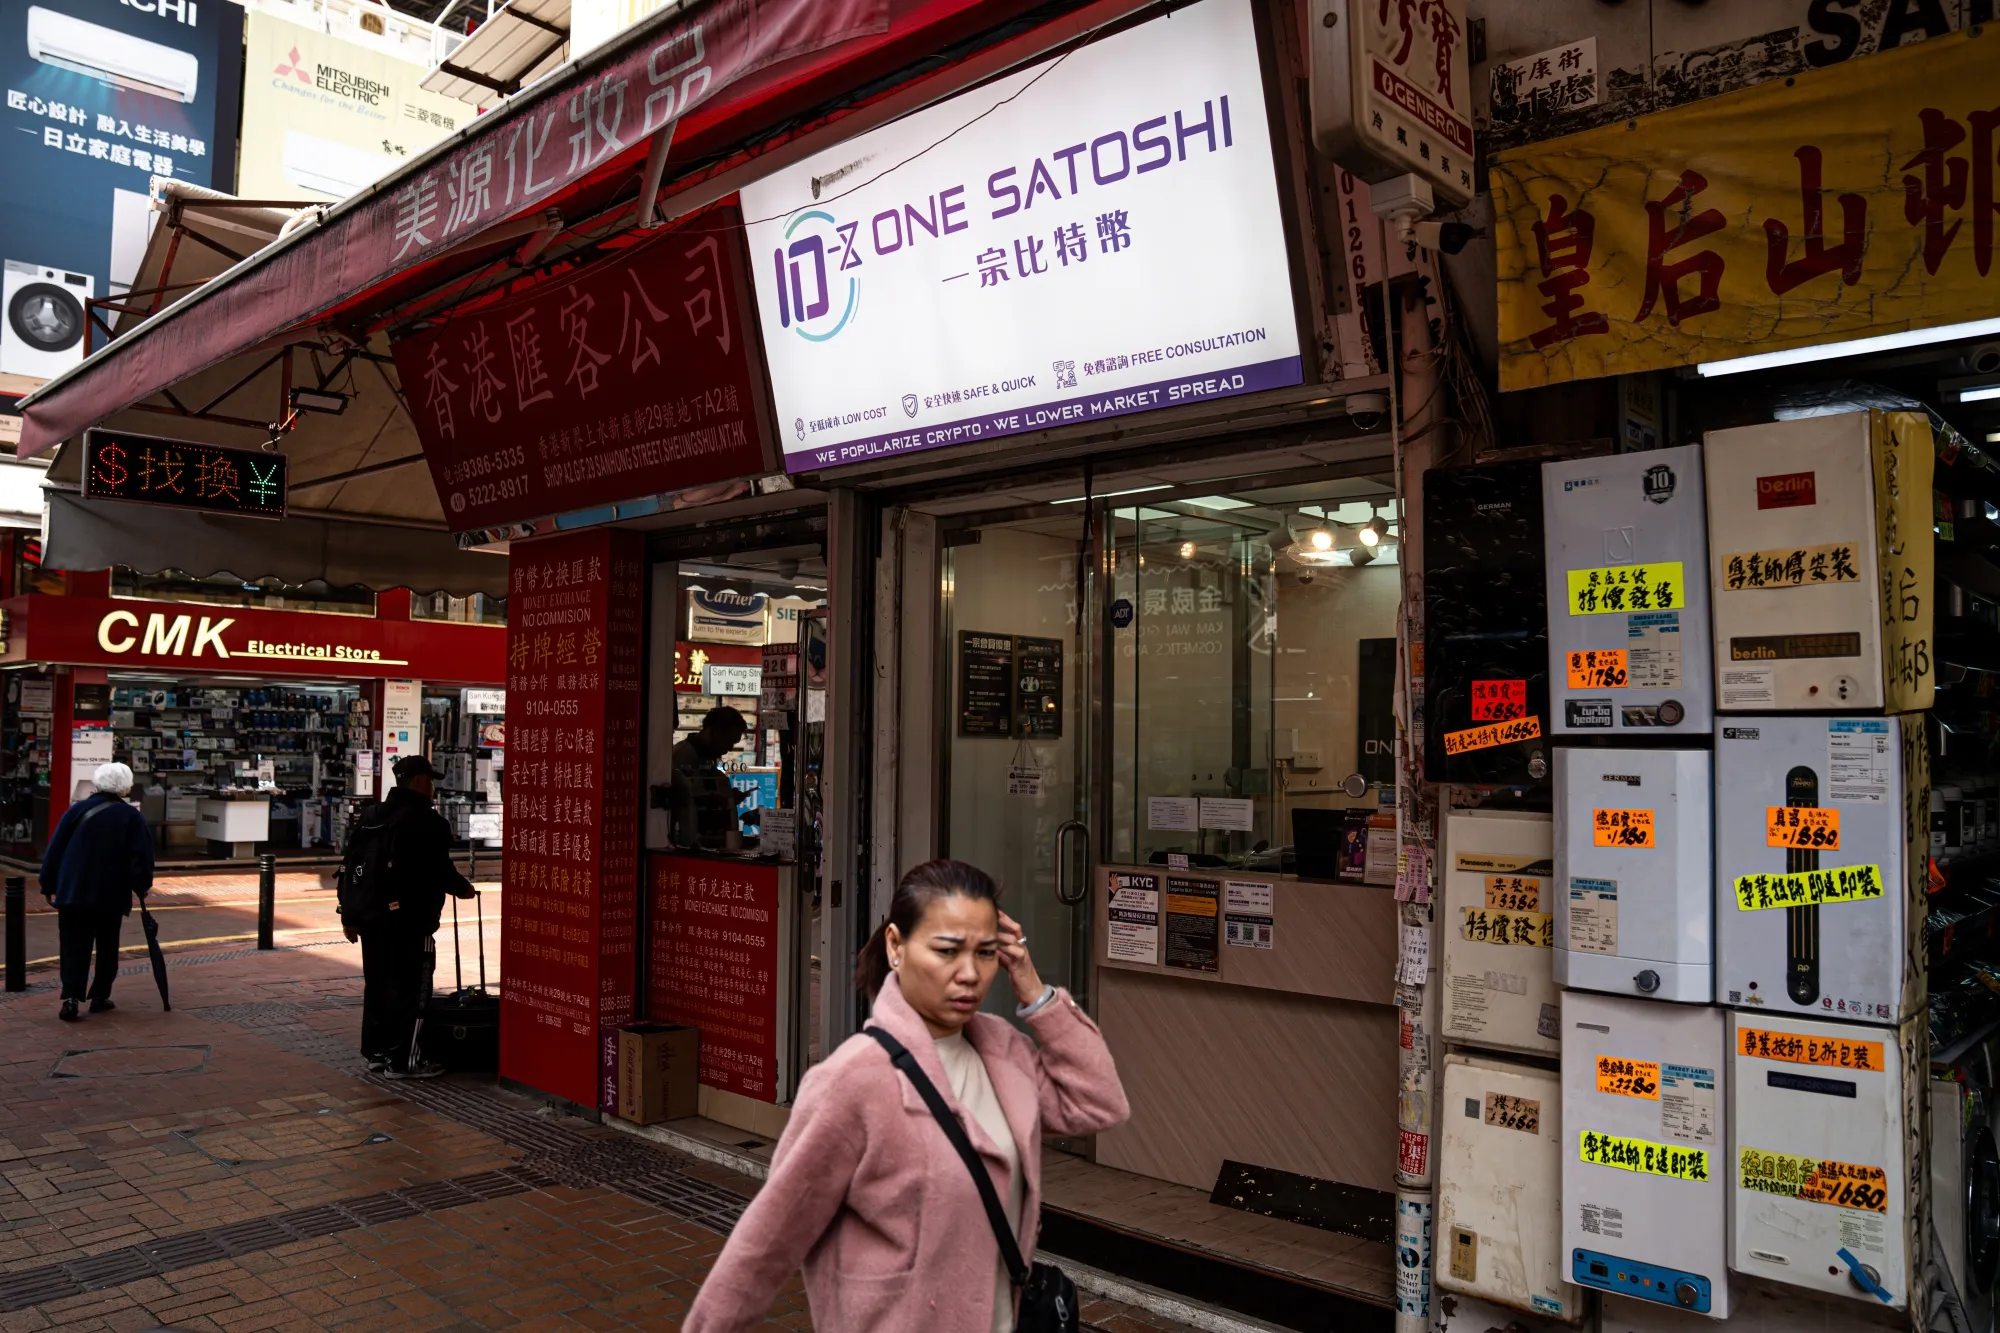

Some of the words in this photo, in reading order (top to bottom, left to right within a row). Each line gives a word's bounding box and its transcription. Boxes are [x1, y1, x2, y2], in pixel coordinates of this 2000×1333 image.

[316, 76, 379, 106] ELECTRIC
[317, 64, 390, 97] MITSUBISHI
[7, 89, 88, 127] 匠心設計
[96, 113, 206, 157] 融入生活美學
[44, 126, 174, 177] 日立家庭電器
[871, 183, 969, 256] ONE
[987, 94, 1234, 220] SATOSHI
[942, 208, 1133, 289] 一宗比特幣
[423, 235, 732, 440] 香港匯客公司
[1131, 348, 1164, 366] FREE
[1166, 327, 1267, 359] CONSULTATION
[924, 389, 962, 409] 安全快速
[963, 384, 990, 400] SAFE
[992, 383, 1000, 394] &
[1001, 375, 1037, 392] QUICK
[816, 449, 837, 463] WE
[841, 434, 922, 460] POPULARIZE
[926, 422, 982, 444] CRYPTO
[993, 415, 1020, 431] WE
[1025, 403, 1084, 427] LOWER
[1090, 389, 1160, 415] MARKET
[1168, 373, 1246, 401] SPREAD
[842, 411, 861, 426] LOW
[863, 406, 888, 421] COST
[468, 474, 530, 507] 5222-8917
[1759, 478, 1813, 495] berlin
[522, 594, 546, 611] MONEY
[549, 588, 592, 607] EXCHANGE
[1577, 582, 1675, 612] 特價發售
[97, 609, 237, 659] CMK
[247, 640, 331, 659] Electrical
[335, 645, 381, 661] Store
[522, 613, 535, 627] NO
[509, 626, 602, 671] 持牌經營
[1732, 646, 1777, 660] berlin
[712, 667, 727, 677] San
[728, 668, 747, 679] Kung
[526, 699, 579, 715] 9104-0555
[1581, 705, 1610, 716] turbo
[511, 726, 550, 754] 集團經營
[554, 727, 595, 755] 信心保證
[510, 759, 549, 789] 安全可靠
[1460, 859, 1494, 868] Panasonic
[687, 875, 755, 902] 货币兑换汇款
[1131, 876, 1154, 889] KYC
[721, 930, 766, 948] 9104-0555
